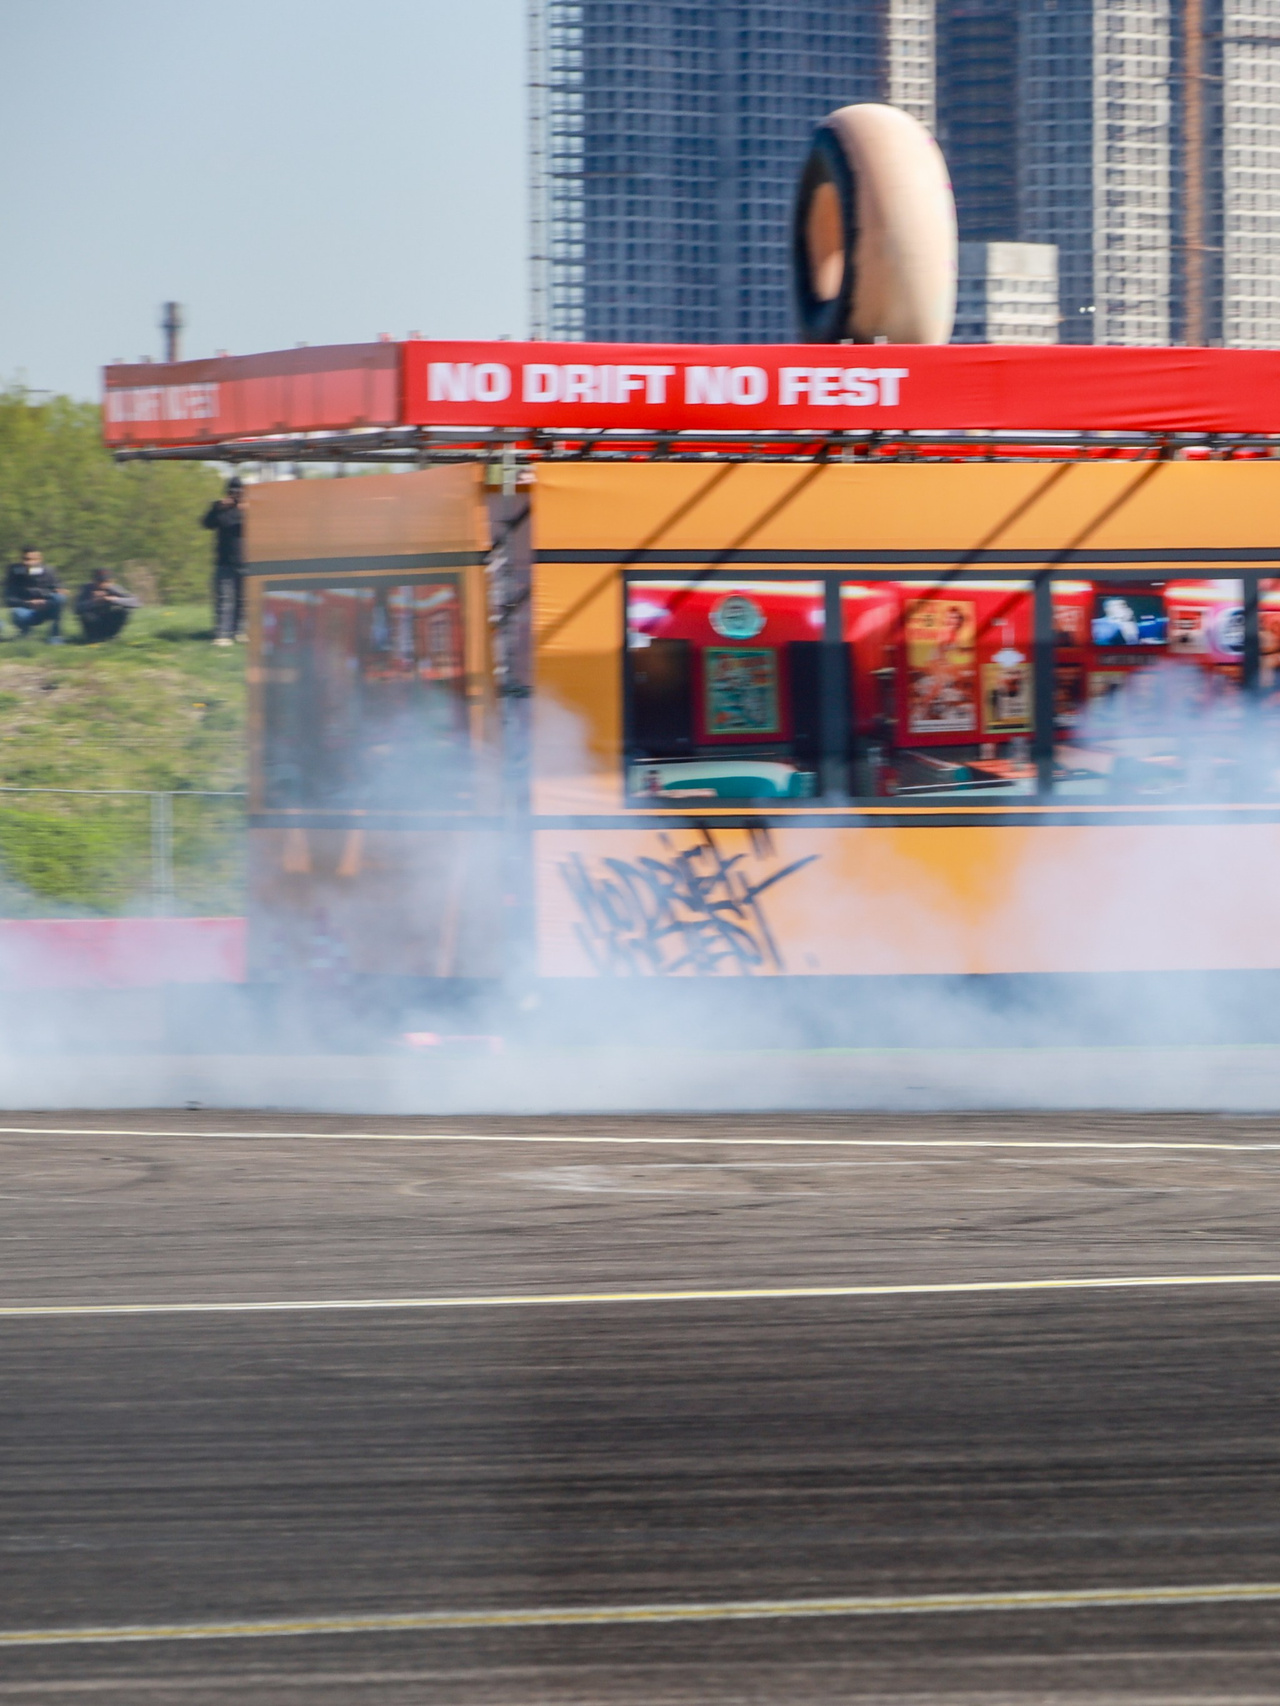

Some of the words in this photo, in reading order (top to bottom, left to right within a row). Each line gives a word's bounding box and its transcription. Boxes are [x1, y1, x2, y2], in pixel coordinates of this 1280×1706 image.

[427, 362, 512, 402] NO
[522, 364, 677, 404] DRIFT
[684, 366, 769, 405] NO
[778, 367, 909, 407] FEST
